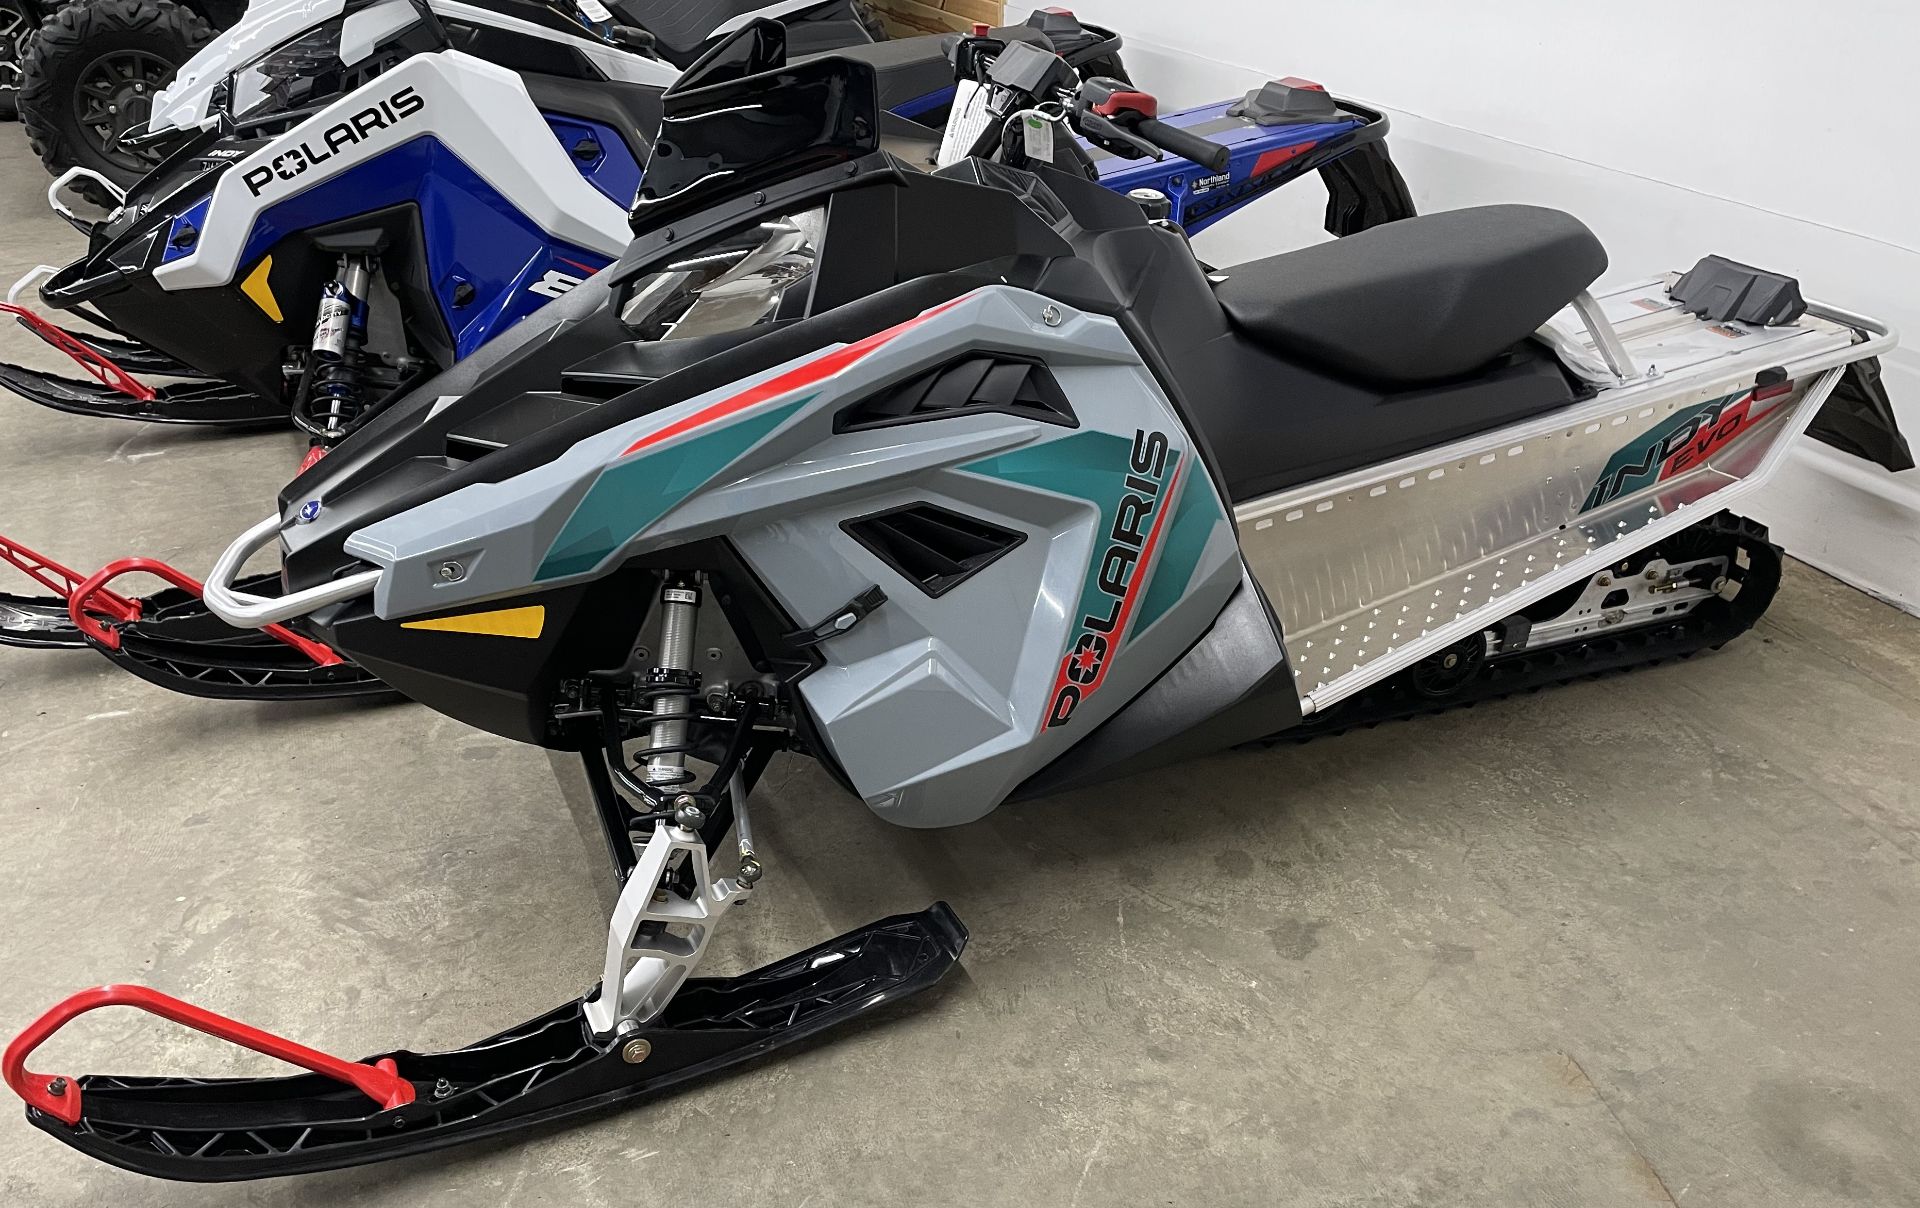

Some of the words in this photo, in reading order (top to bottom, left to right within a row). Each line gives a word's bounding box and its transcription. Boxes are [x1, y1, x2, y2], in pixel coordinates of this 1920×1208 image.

[207, 149, 245, 158] INDY
[242, 86, 425, 197] POLARIS
[1199, 171, 1230, 186] Northland
[1591, 393, 1736, 509] INDY
[1670, 414, 1743, 475] EVO
[1048, 428, 1169, 728] POLARIS
